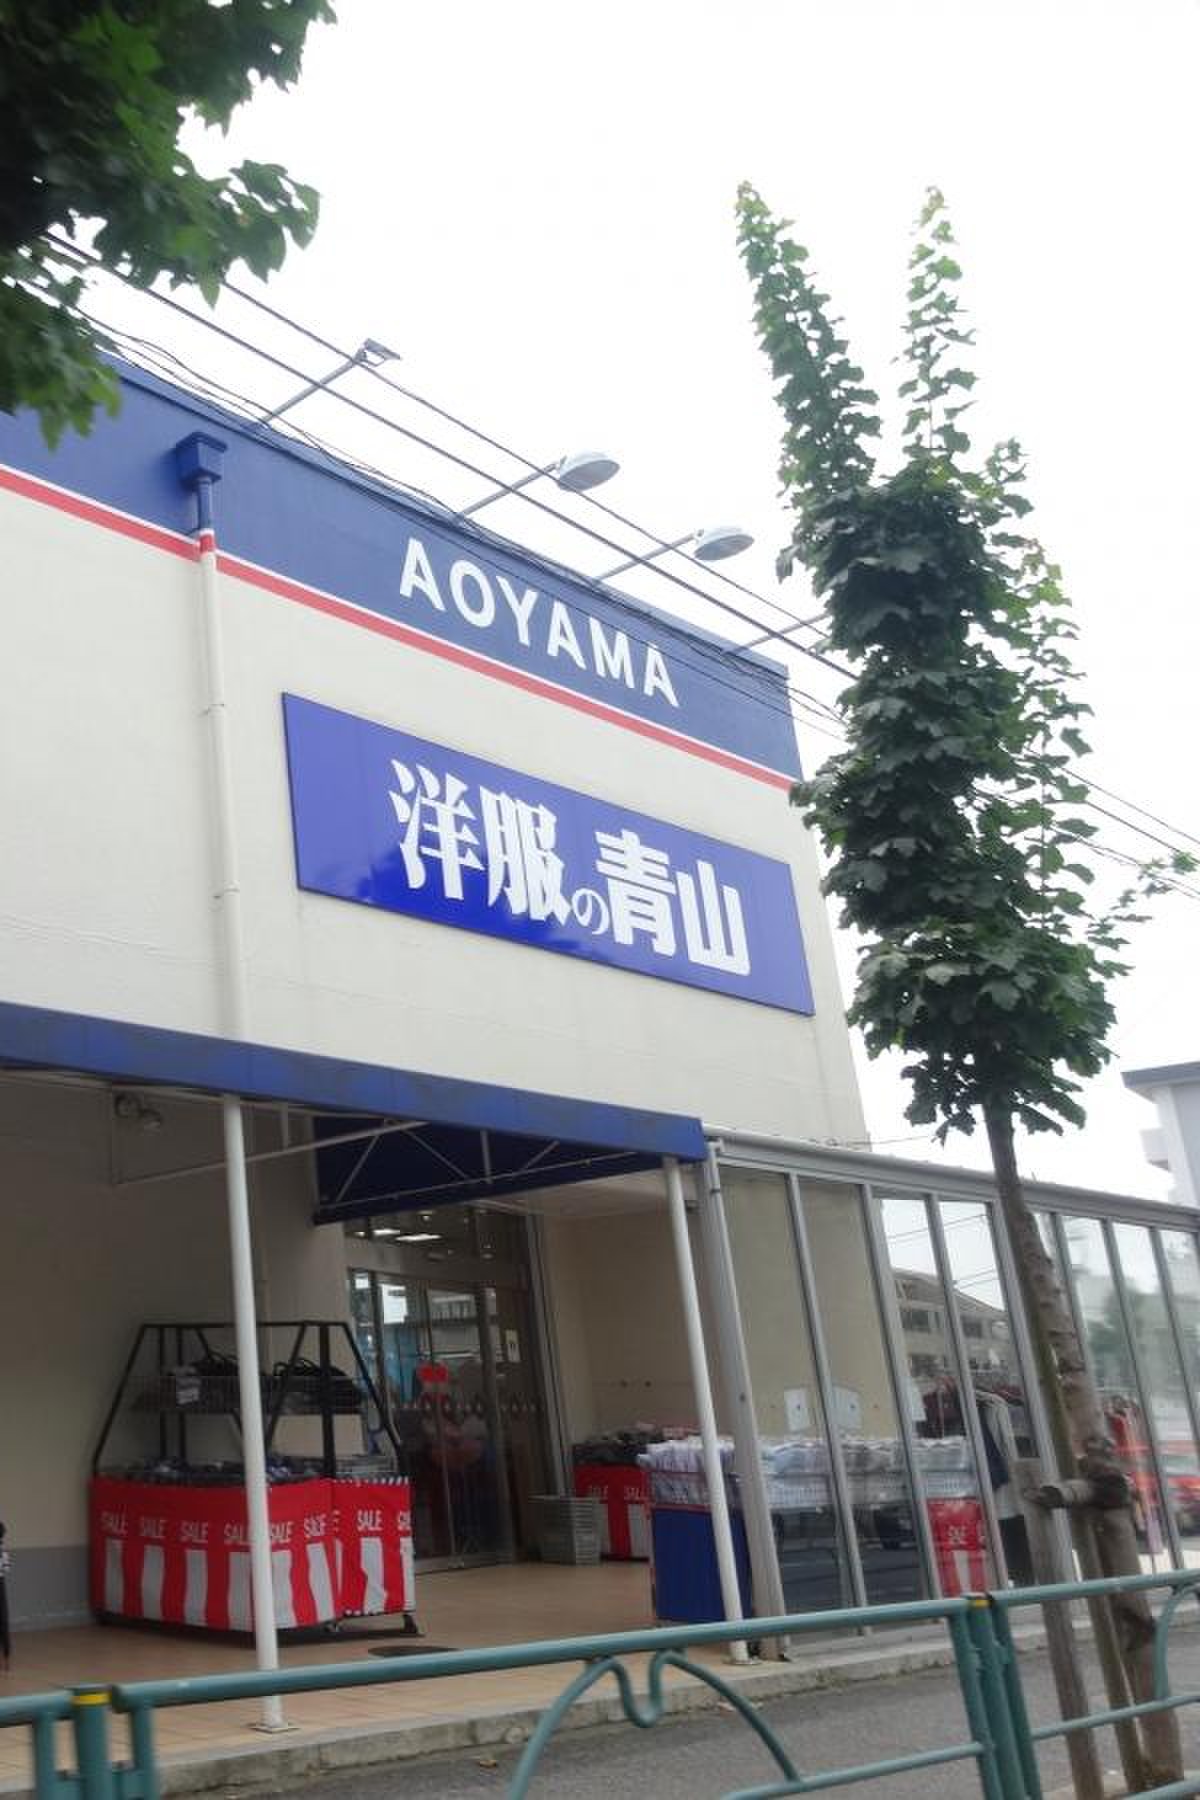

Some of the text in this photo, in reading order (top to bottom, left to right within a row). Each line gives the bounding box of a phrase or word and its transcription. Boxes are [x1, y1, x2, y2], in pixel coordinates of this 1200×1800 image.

[399, 537, 680, 708] AOYAMA
[388, 758, 751, 977] 洋服の青山
[223, 1520, 252, 1546] SAL
[356, 1509, 384, 1532] SALE
